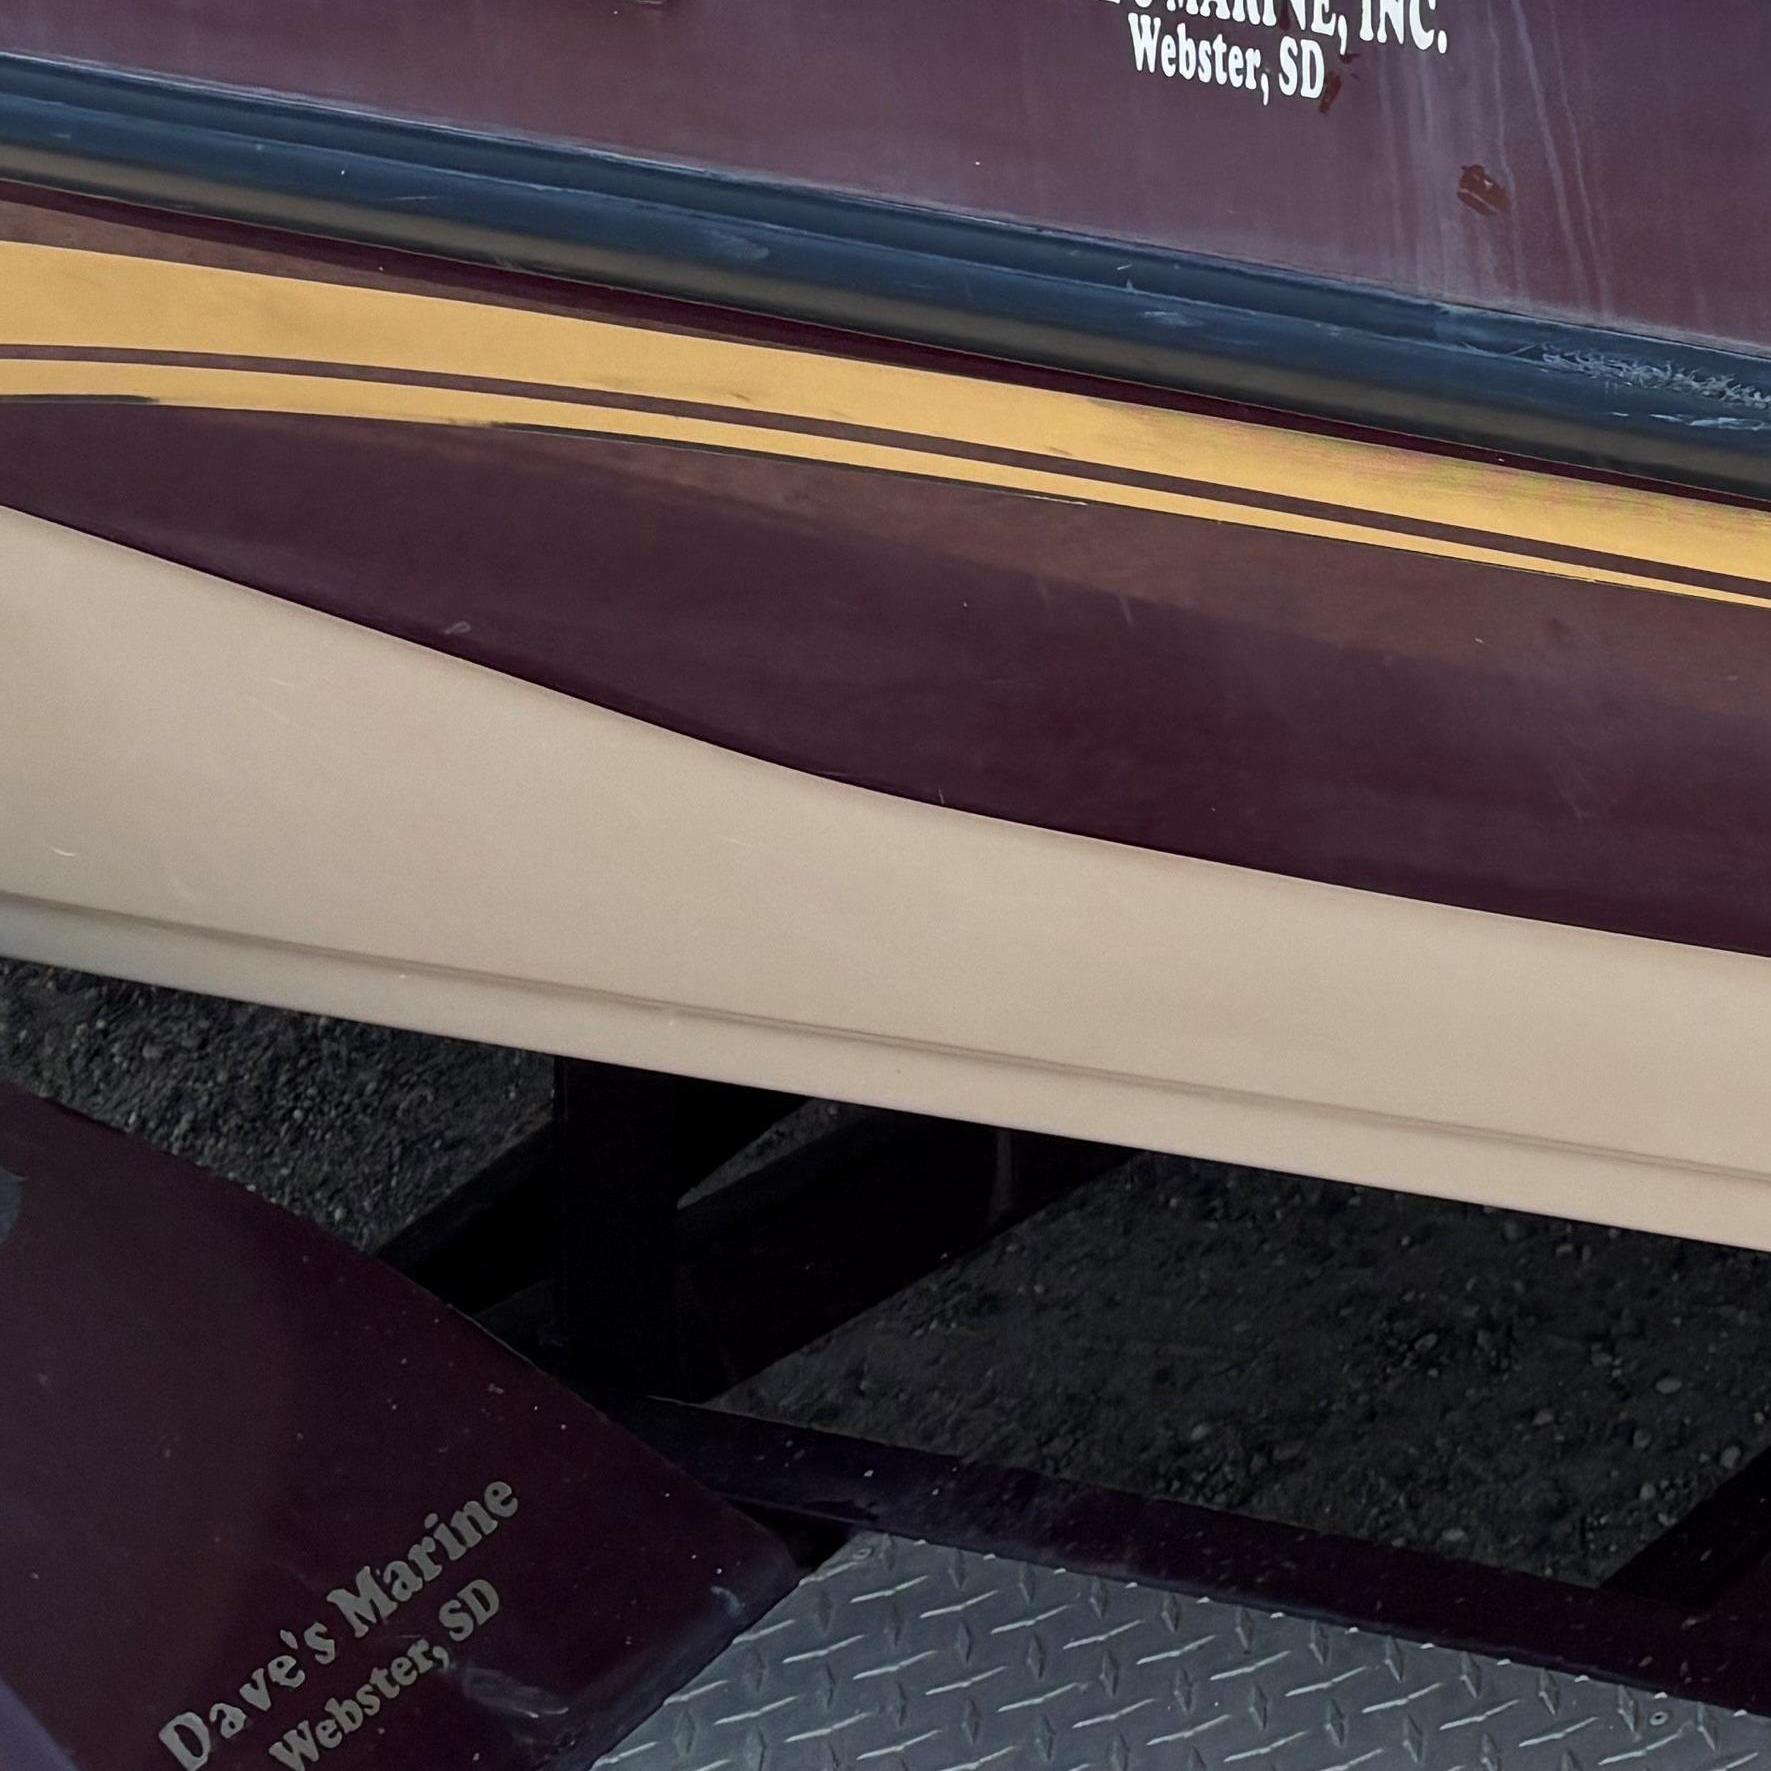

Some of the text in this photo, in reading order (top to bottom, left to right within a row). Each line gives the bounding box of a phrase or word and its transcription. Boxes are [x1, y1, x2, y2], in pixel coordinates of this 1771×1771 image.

[1128, 13, 1326, 106] Webster, SD
[158, 1480, 519, 1771] Dave's Marine
[268, 1578, 500, 1771] Webster, SD
